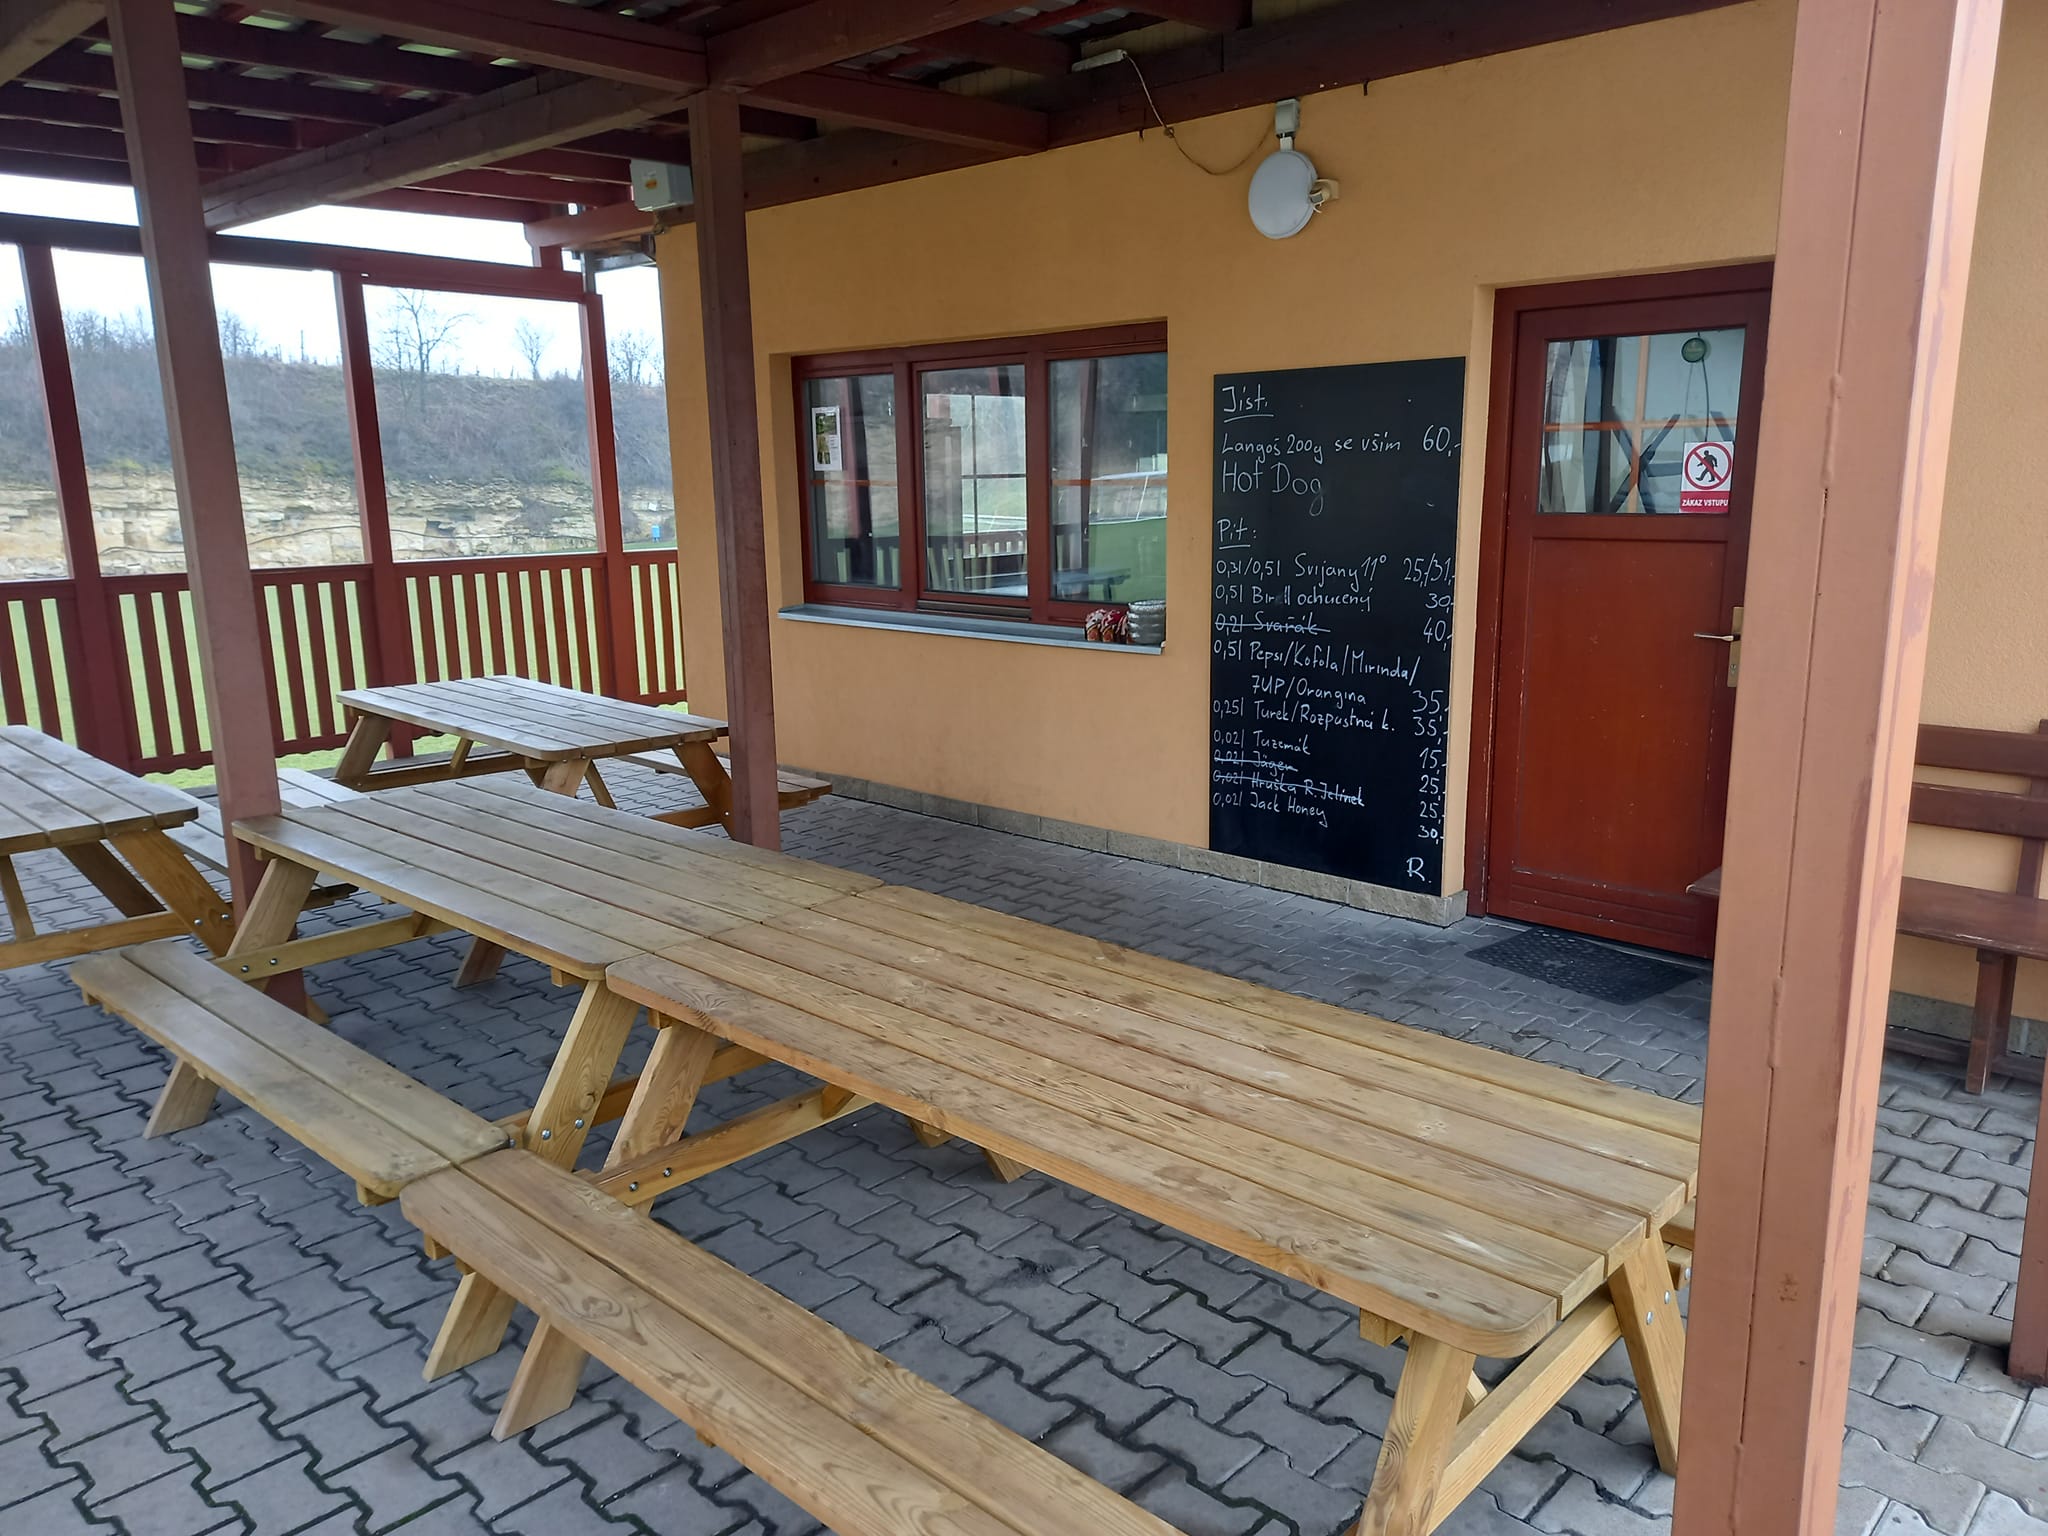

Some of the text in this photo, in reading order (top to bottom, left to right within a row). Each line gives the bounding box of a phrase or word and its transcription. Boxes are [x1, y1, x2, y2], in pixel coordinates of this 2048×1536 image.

[1286, 433, 1323, 464] 200g
[1334, 438, 1353, 452] se
[1221, 459, 1324, 517] Hot Dog
[1681, 498, 1729, 507] ZÁKAZ VSTUPU
[1294, 552, 1360, 593] Svijany
[1249, 791, 1280, 813] Jack
[1287, 795, 1328, 828] Honey
